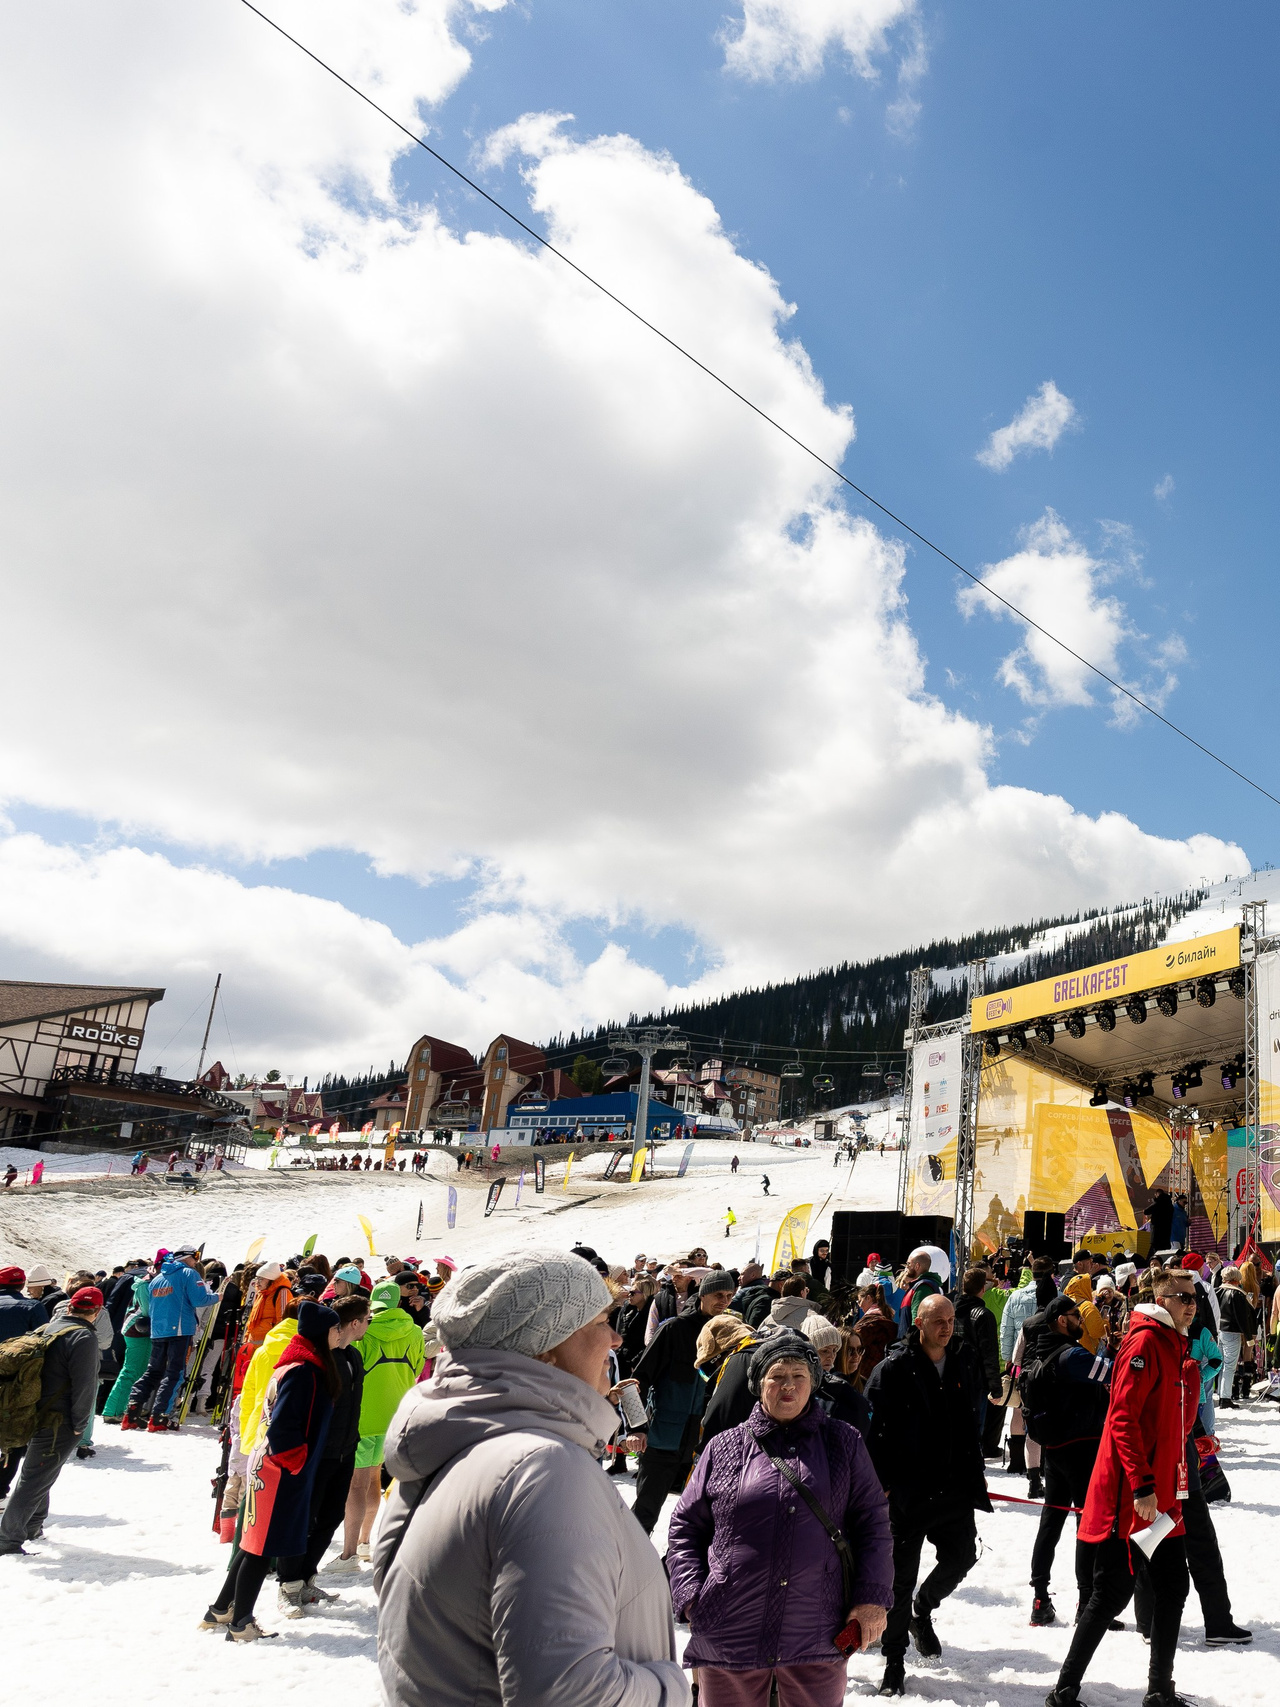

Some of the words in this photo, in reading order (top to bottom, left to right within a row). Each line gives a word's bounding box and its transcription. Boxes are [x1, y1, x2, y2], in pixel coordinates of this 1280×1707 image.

[1177, 945, 1217, 966] билайн
[1053, 963, 1129, 1003] GRELKAFEST
[71, 1025, 140, 1047] ROOKS
[101, 1023, 118, 1032] THE
